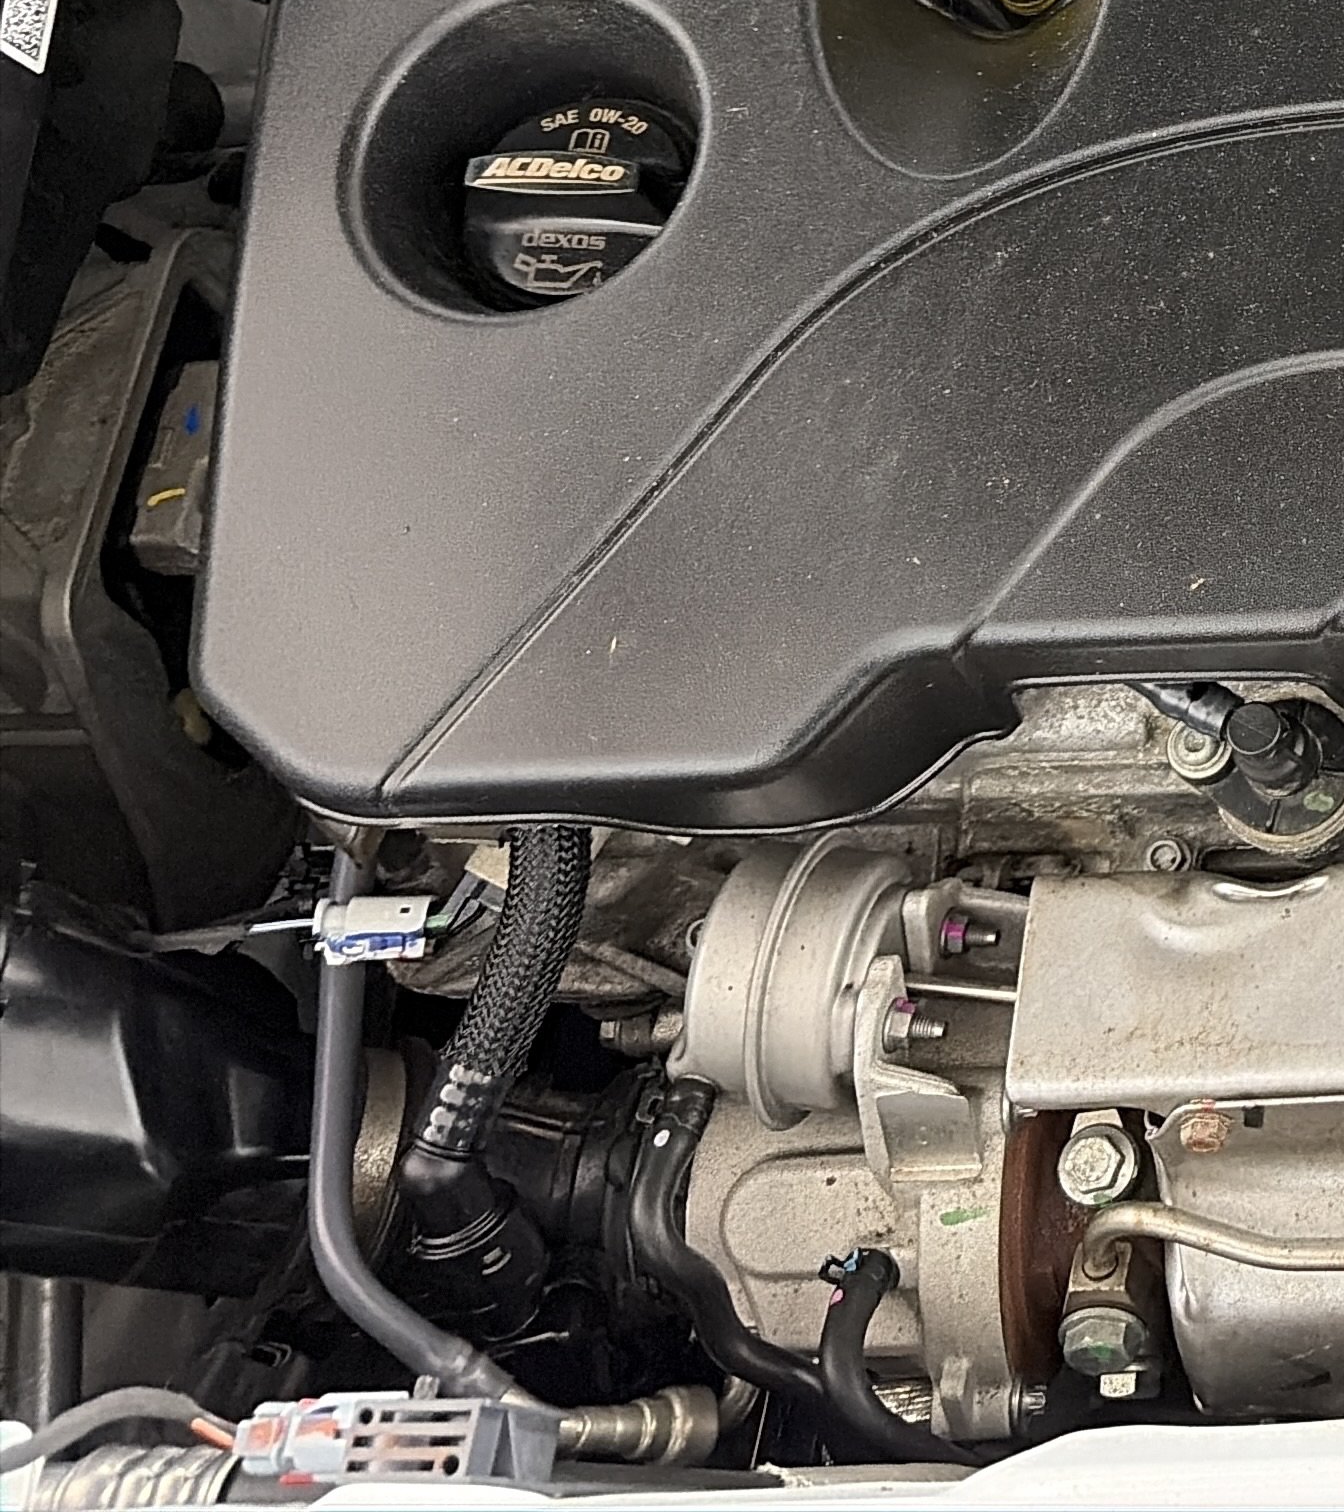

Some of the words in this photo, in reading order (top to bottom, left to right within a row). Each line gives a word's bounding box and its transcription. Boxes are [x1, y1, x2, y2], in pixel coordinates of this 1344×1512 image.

[540, 109, 580, 132] SAE
[589, 107, 649, 135] 0W-20
[481, 157, 626, 182] ACDelco
[521, 228, 607, 251] dexos
